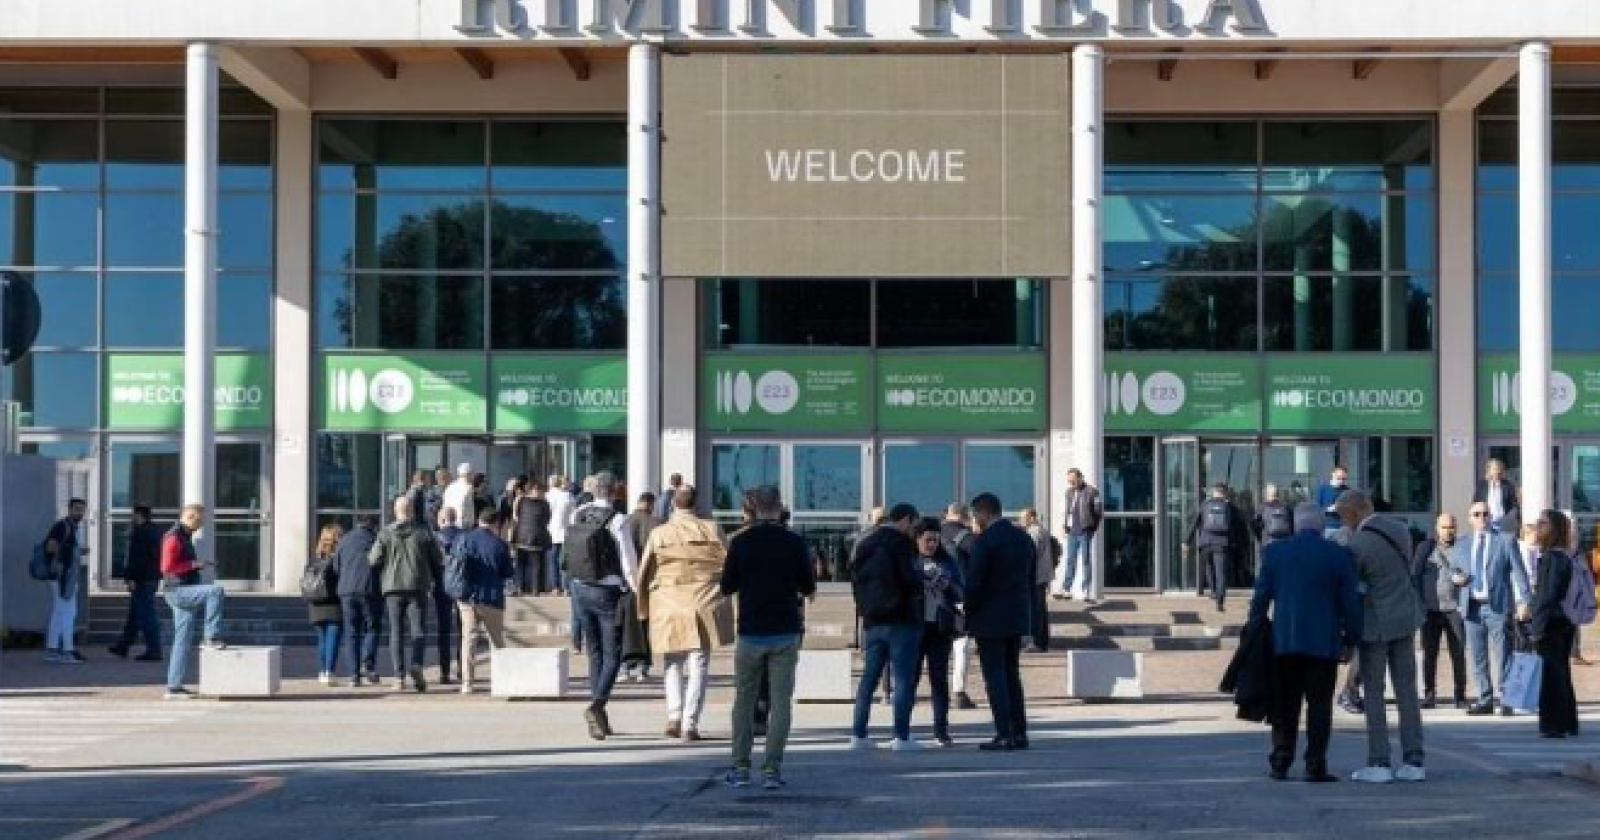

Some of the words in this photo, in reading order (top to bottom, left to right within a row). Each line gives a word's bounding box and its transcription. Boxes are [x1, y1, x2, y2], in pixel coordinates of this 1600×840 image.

[765, 149, 966, 182] WELCOME
[143, 385, 263, 404] ECONDO
[762, 384, 790, 398] E23
[916, 387, 1036, 407] ECOMONDO
[1151, 387, 1178, 400] E23
[1305, 389, 1423, 408] ECOMONDO
